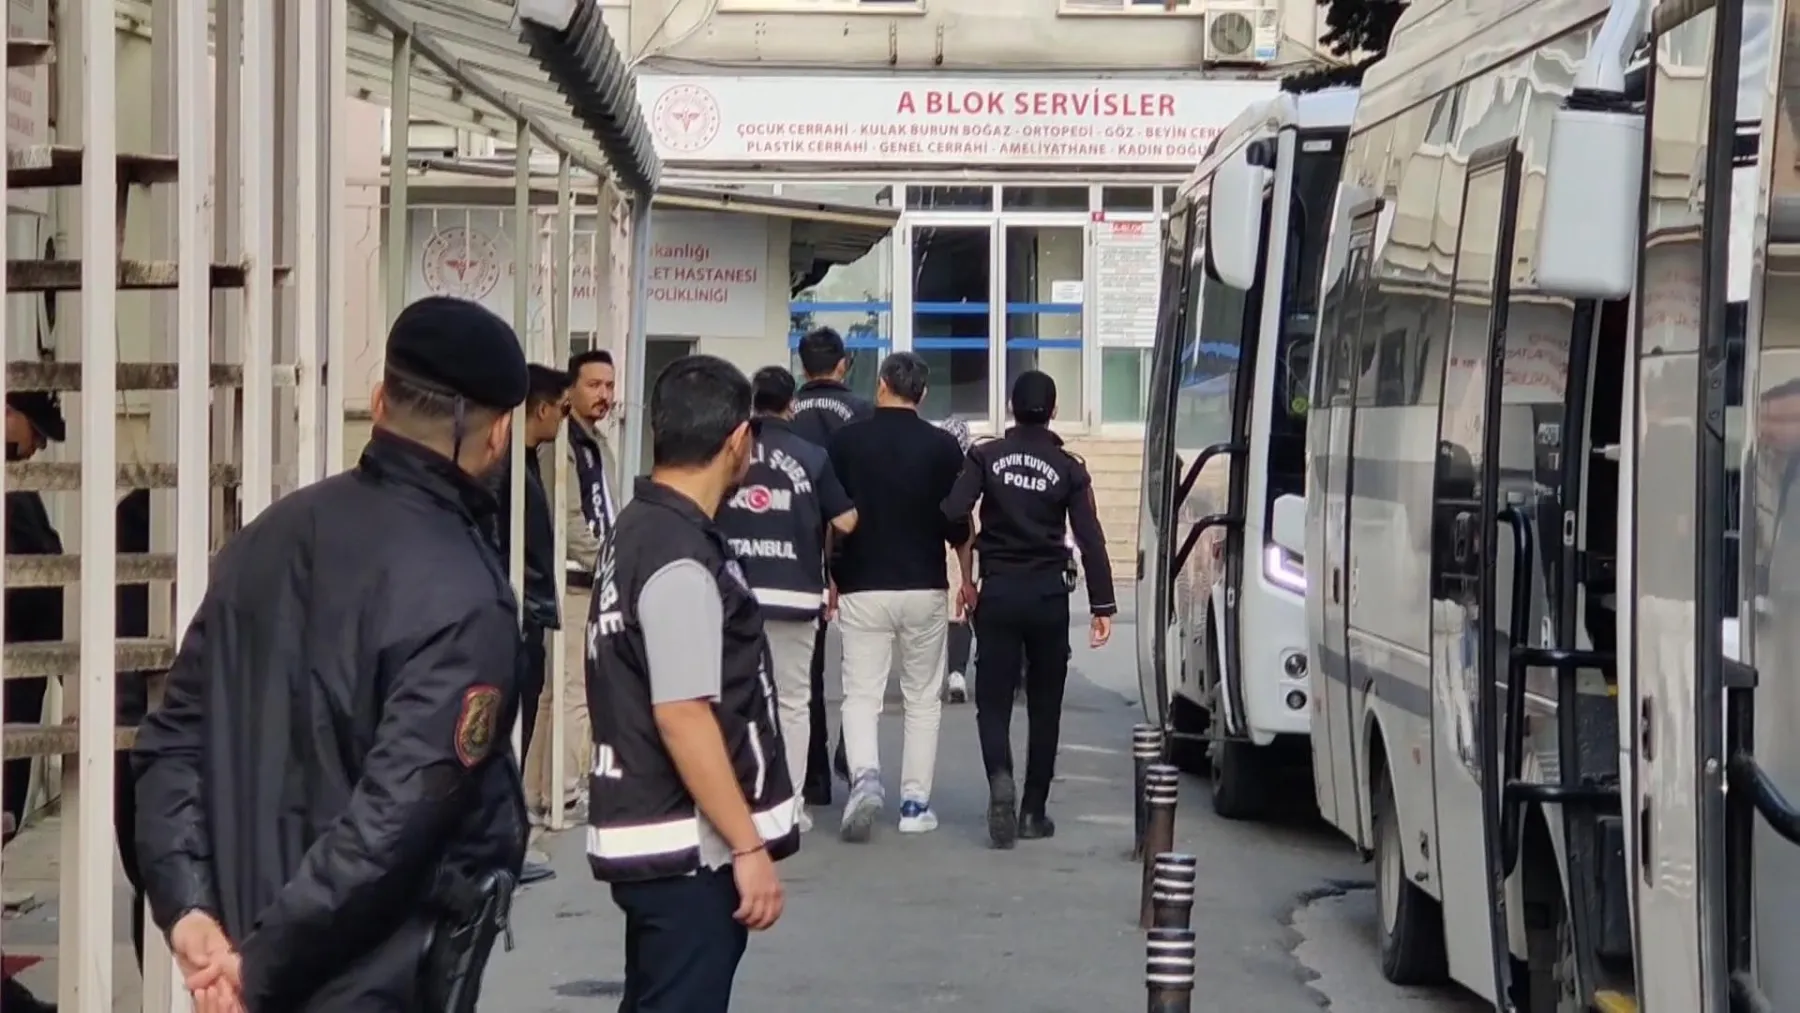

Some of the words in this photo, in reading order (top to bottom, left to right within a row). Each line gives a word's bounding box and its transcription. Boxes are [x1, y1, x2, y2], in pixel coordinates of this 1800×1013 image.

[897, 91, 916, 114] A
[926, 91, 1005, 115] BLOK
[1014, 88, 1176, 117] SERVİSLER
[736, 123, 785, 137] ÇOCUK
[788, 122, 848, 136] CERRAHİ
[860, 124, 907, 136] KULAK
[910, 124, 959, 136] BURUN
[962, 122, 1011, 137] BOĞAZ
[1022, 124, 1093, 138] ORTOPEDİ
[1105, 125, 1134, 138] GÖZ
[1145, 125, 1187, 138] BEYİN
[747, 139, 804, 153] PLASTİK
[807, 140, 868, 153] CERRAHİ
[880, 141, 924, 153] GENEL
[927, 141, 988, 154] CERRAHİ
[999, 140, 1106, 155] AMELİYATHANE
[1118, 143, 1162, 156] KADIN
[1166, 142, 1209, 156] DOĞU
[649, 243, 710, 262] kanlığı
[769, 448, 812, 494] ŞUBE
[1023, 453, 1060, 486] KUVVET
[727, 538, 798, 561] TANBUL
